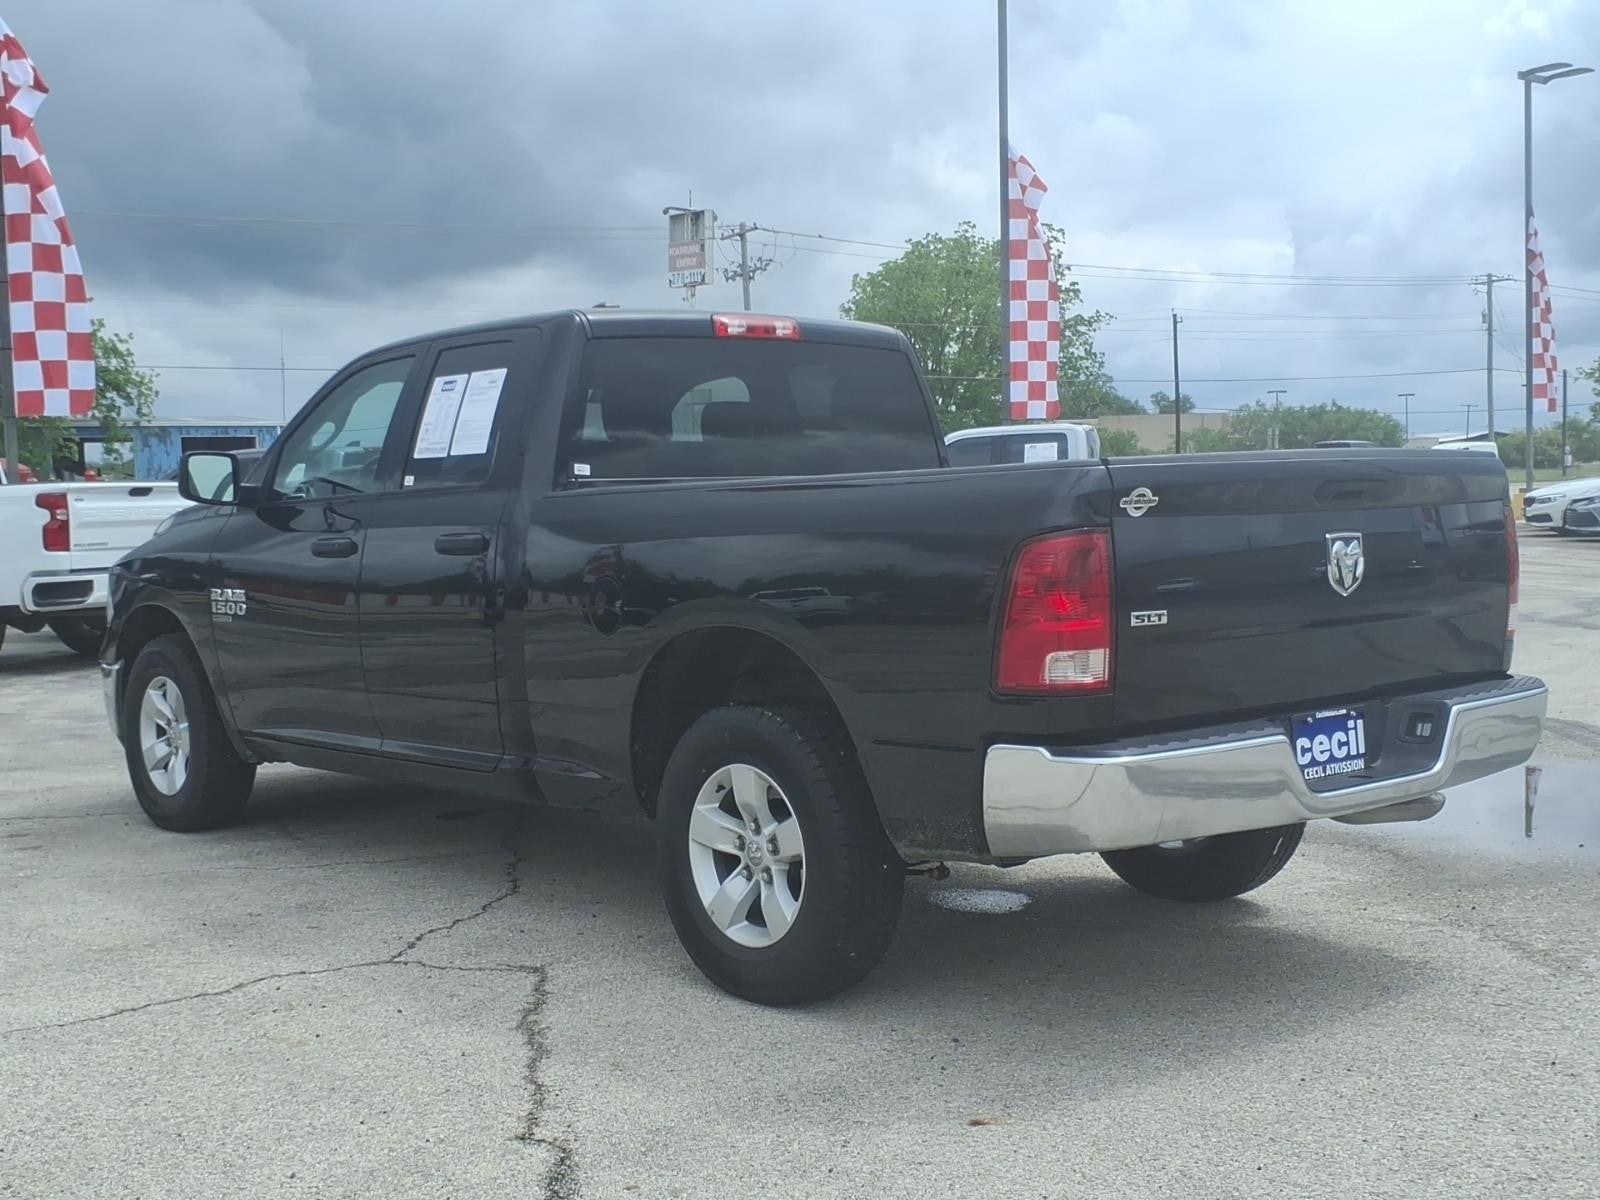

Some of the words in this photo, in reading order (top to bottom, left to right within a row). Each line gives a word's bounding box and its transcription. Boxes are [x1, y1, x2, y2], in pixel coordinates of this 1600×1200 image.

[210, 588, 246, 601] RAM
[211, 601, 247, 616] 1500
[1131, 610, 1167, 626] SLT
[1296, 719, 1366, 766] cecil
[1304, 766, 1325, 780] CECIL
[1326, 758, 1365, 776] ATKISSION
